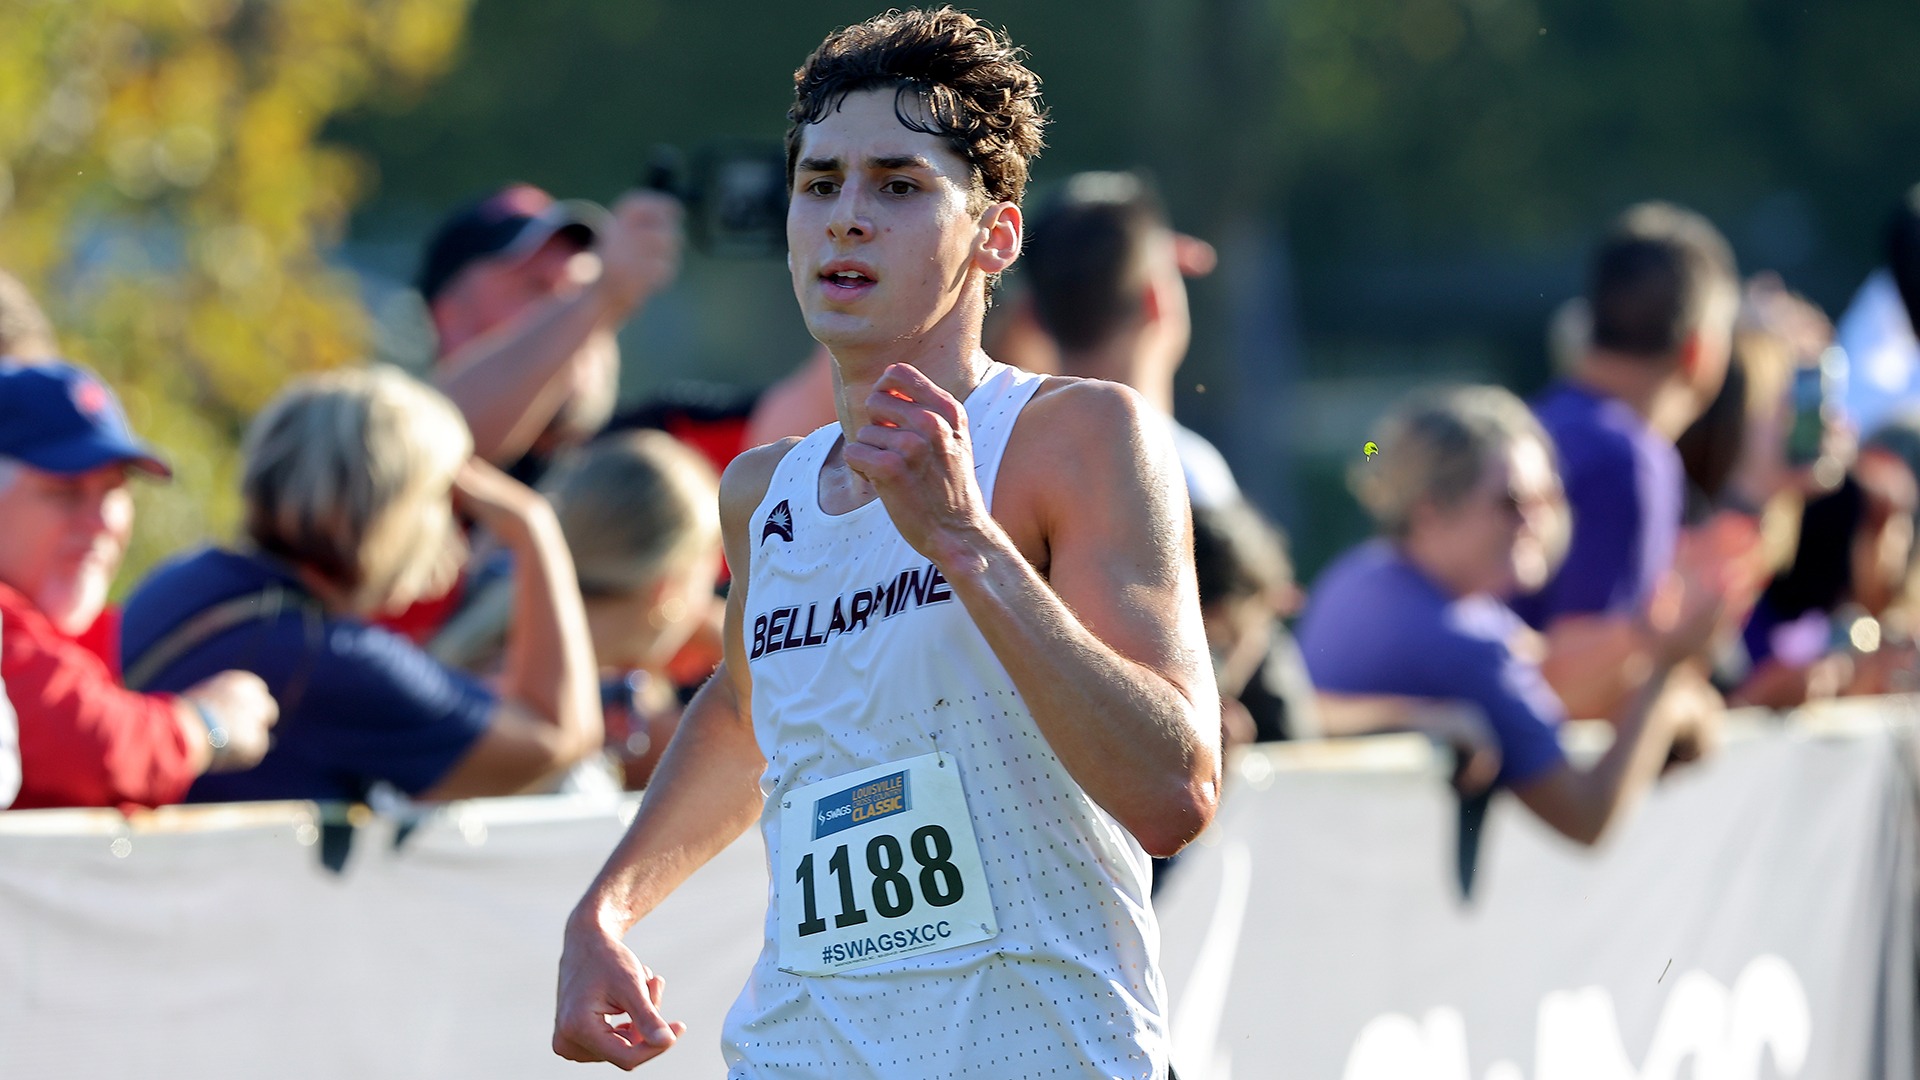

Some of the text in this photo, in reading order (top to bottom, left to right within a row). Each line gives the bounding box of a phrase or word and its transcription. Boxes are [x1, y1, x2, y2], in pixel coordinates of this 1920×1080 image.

[750, 564, 952, 662] BELLARMINE
[852, 776, 902, 800] LOUISVILLE
[852, 788, 902, 808] CROSS COUNTRY
[826, 804, 852, 820] SWAGS
[852, 795, 902, 822] CLASSIC
[796, 825, 964, 937] 1188
[822, 921, 951, 964] #SWAGSXCC
